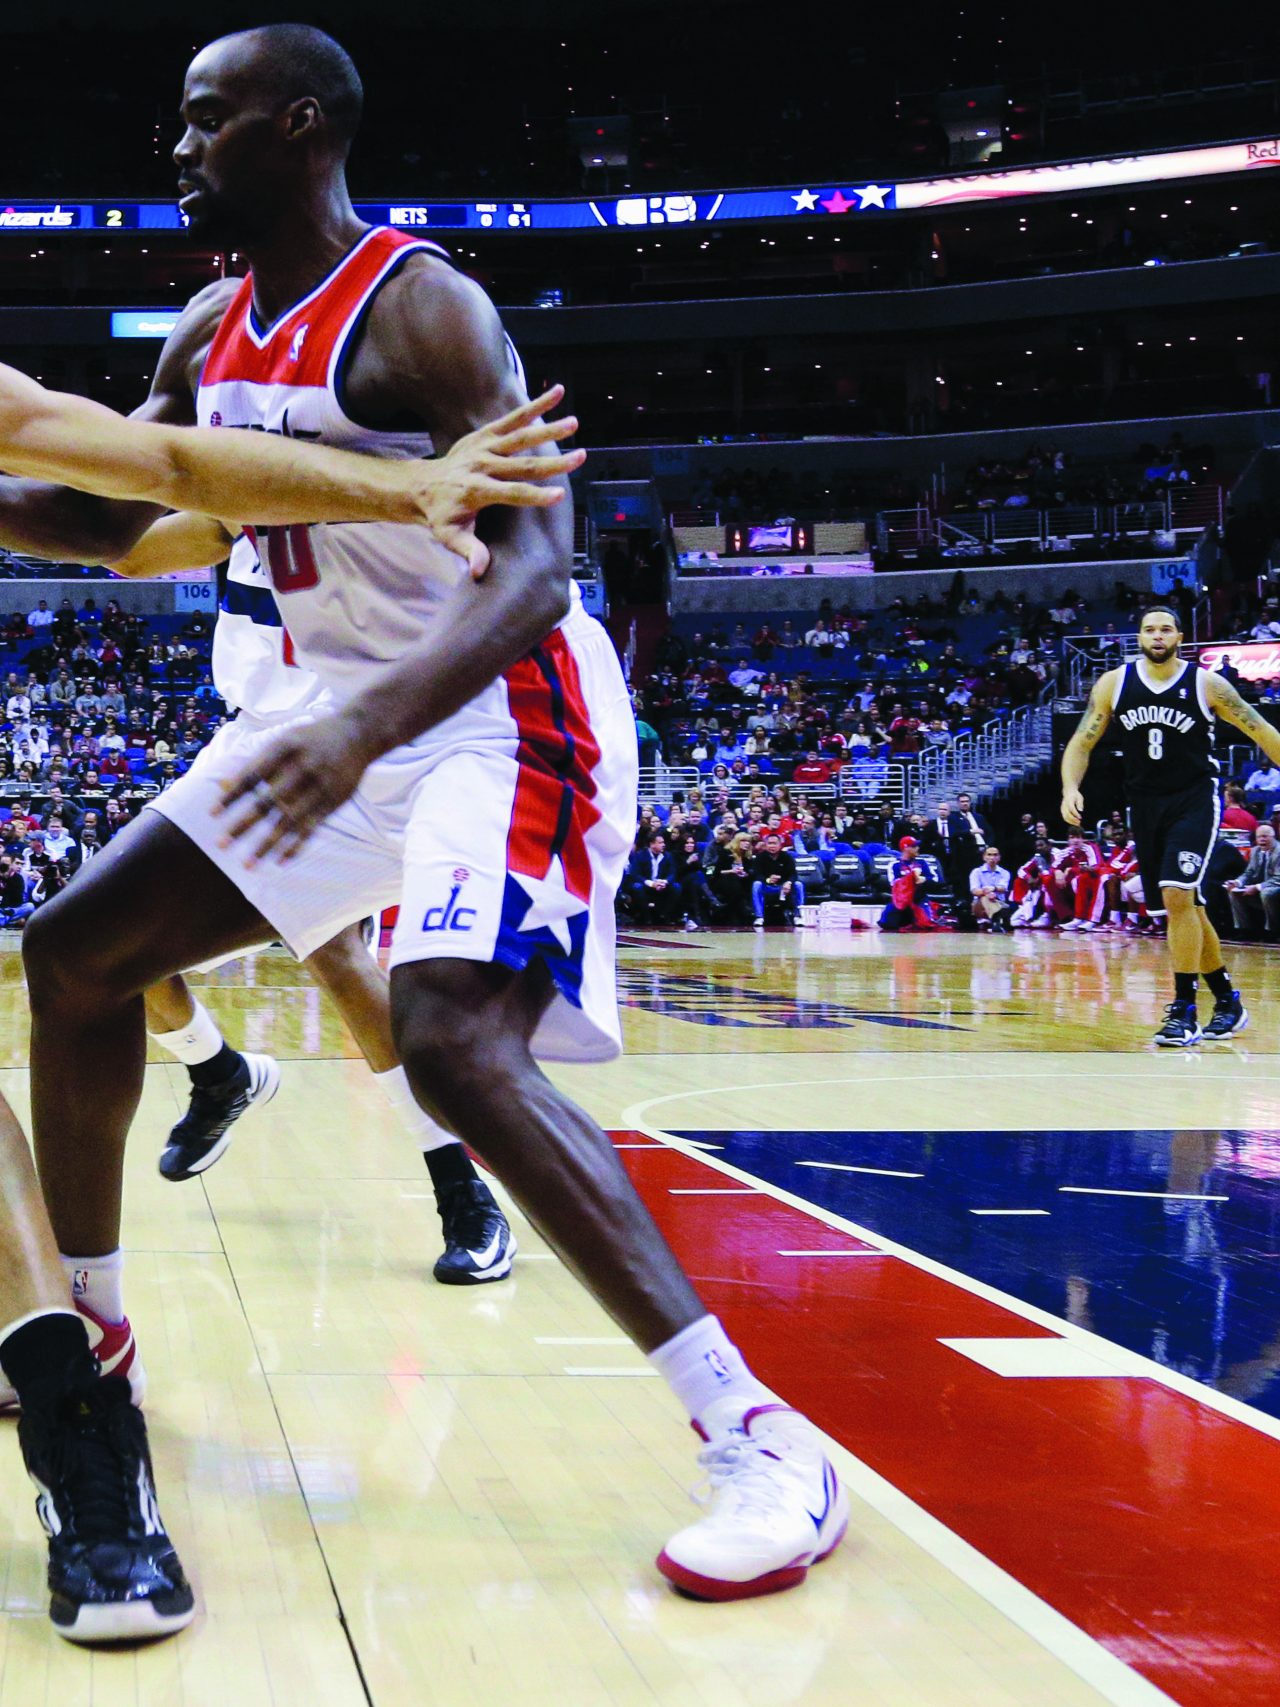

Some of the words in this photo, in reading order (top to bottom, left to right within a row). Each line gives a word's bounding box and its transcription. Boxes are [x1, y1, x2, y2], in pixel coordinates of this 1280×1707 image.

[1247, 140, 1278, 159] Red
[106, 210, 122, 227] 2
[389, 207, 428, 225] NETS
[480, 213, 493, 227] 0
[507, 213, 531, 227] 61
[1158, 563, 1190, 580] 104
[182, 584, 211, 599] 106
[1119, 705, 1196, 734] BROOKLYN
[1148, 728, 1163, 760] 8
[422, 884, 477, 932] dc
